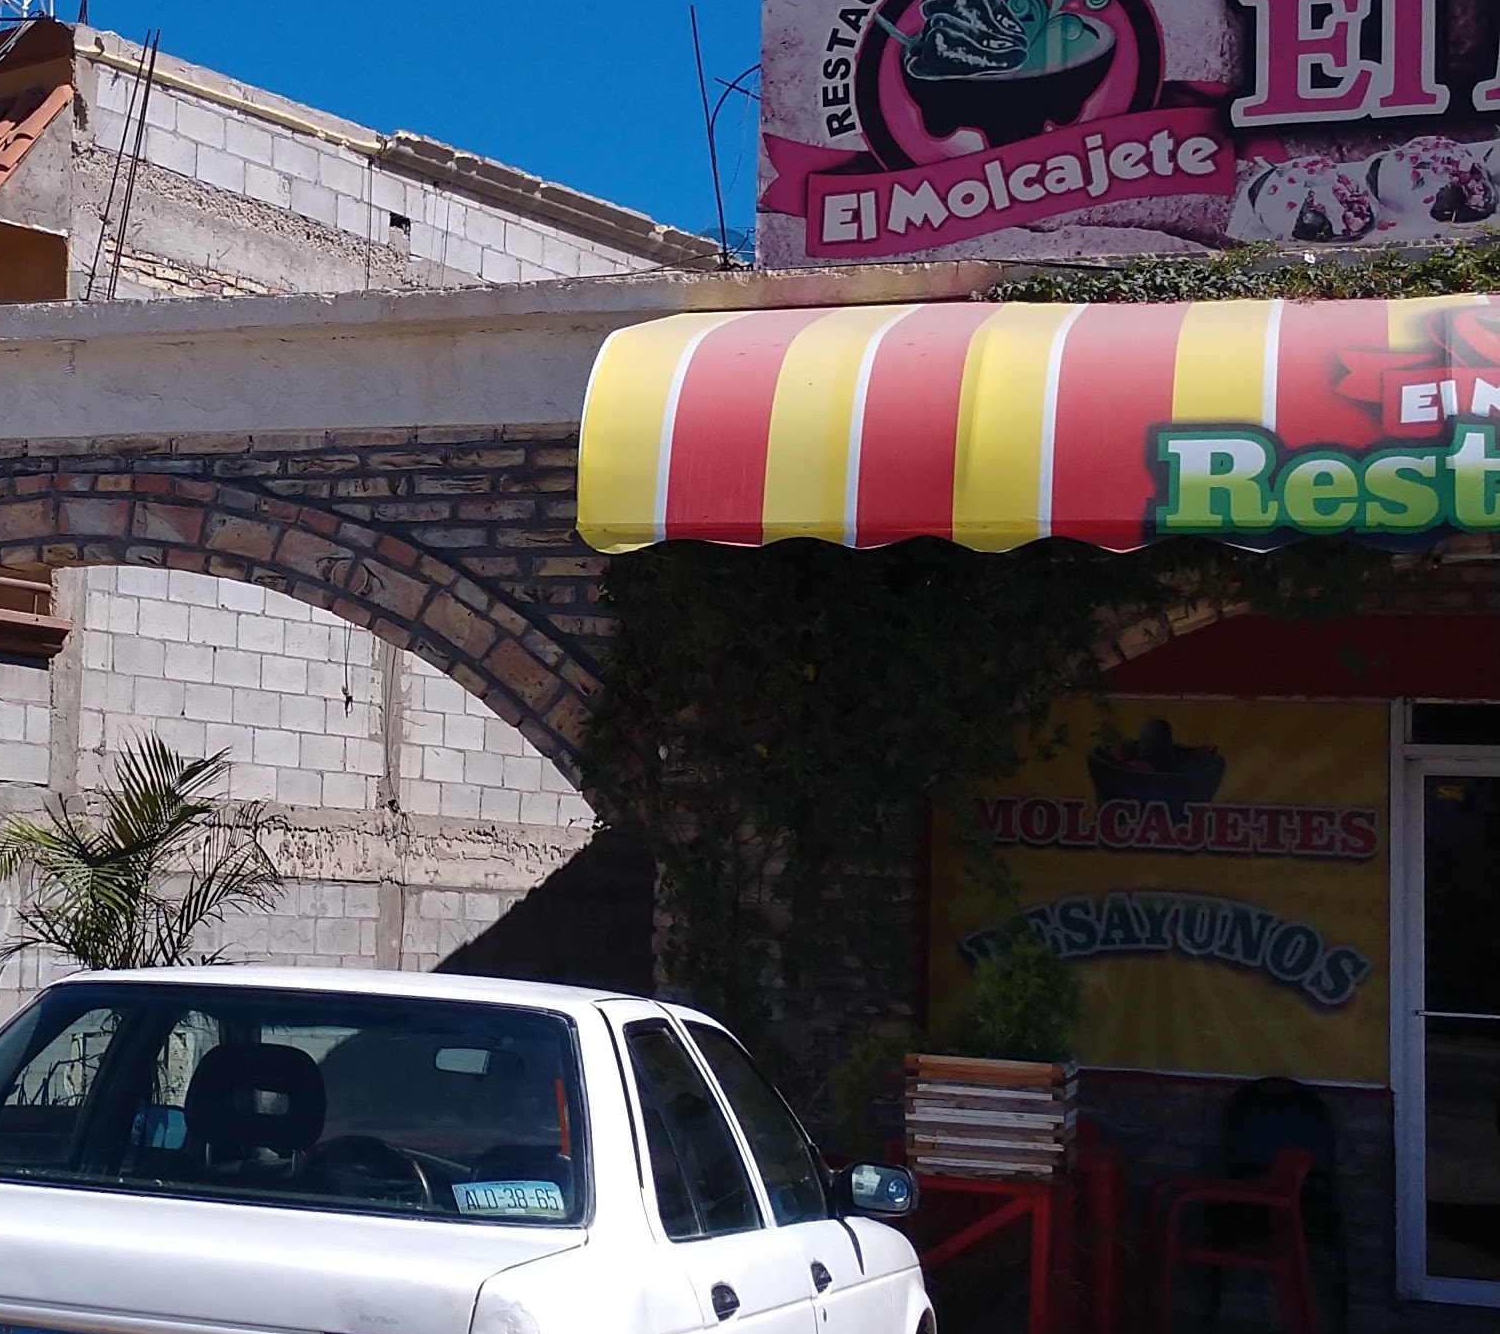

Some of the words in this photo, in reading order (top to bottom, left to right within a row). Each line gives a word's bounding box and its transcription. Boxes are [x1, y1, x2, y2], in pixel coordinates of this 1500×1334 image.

[821, 190, 879, 244] El
[886, 128, 1220, 236] Molcajete
[465, 1187, 560, 1211] ALD-38-65
